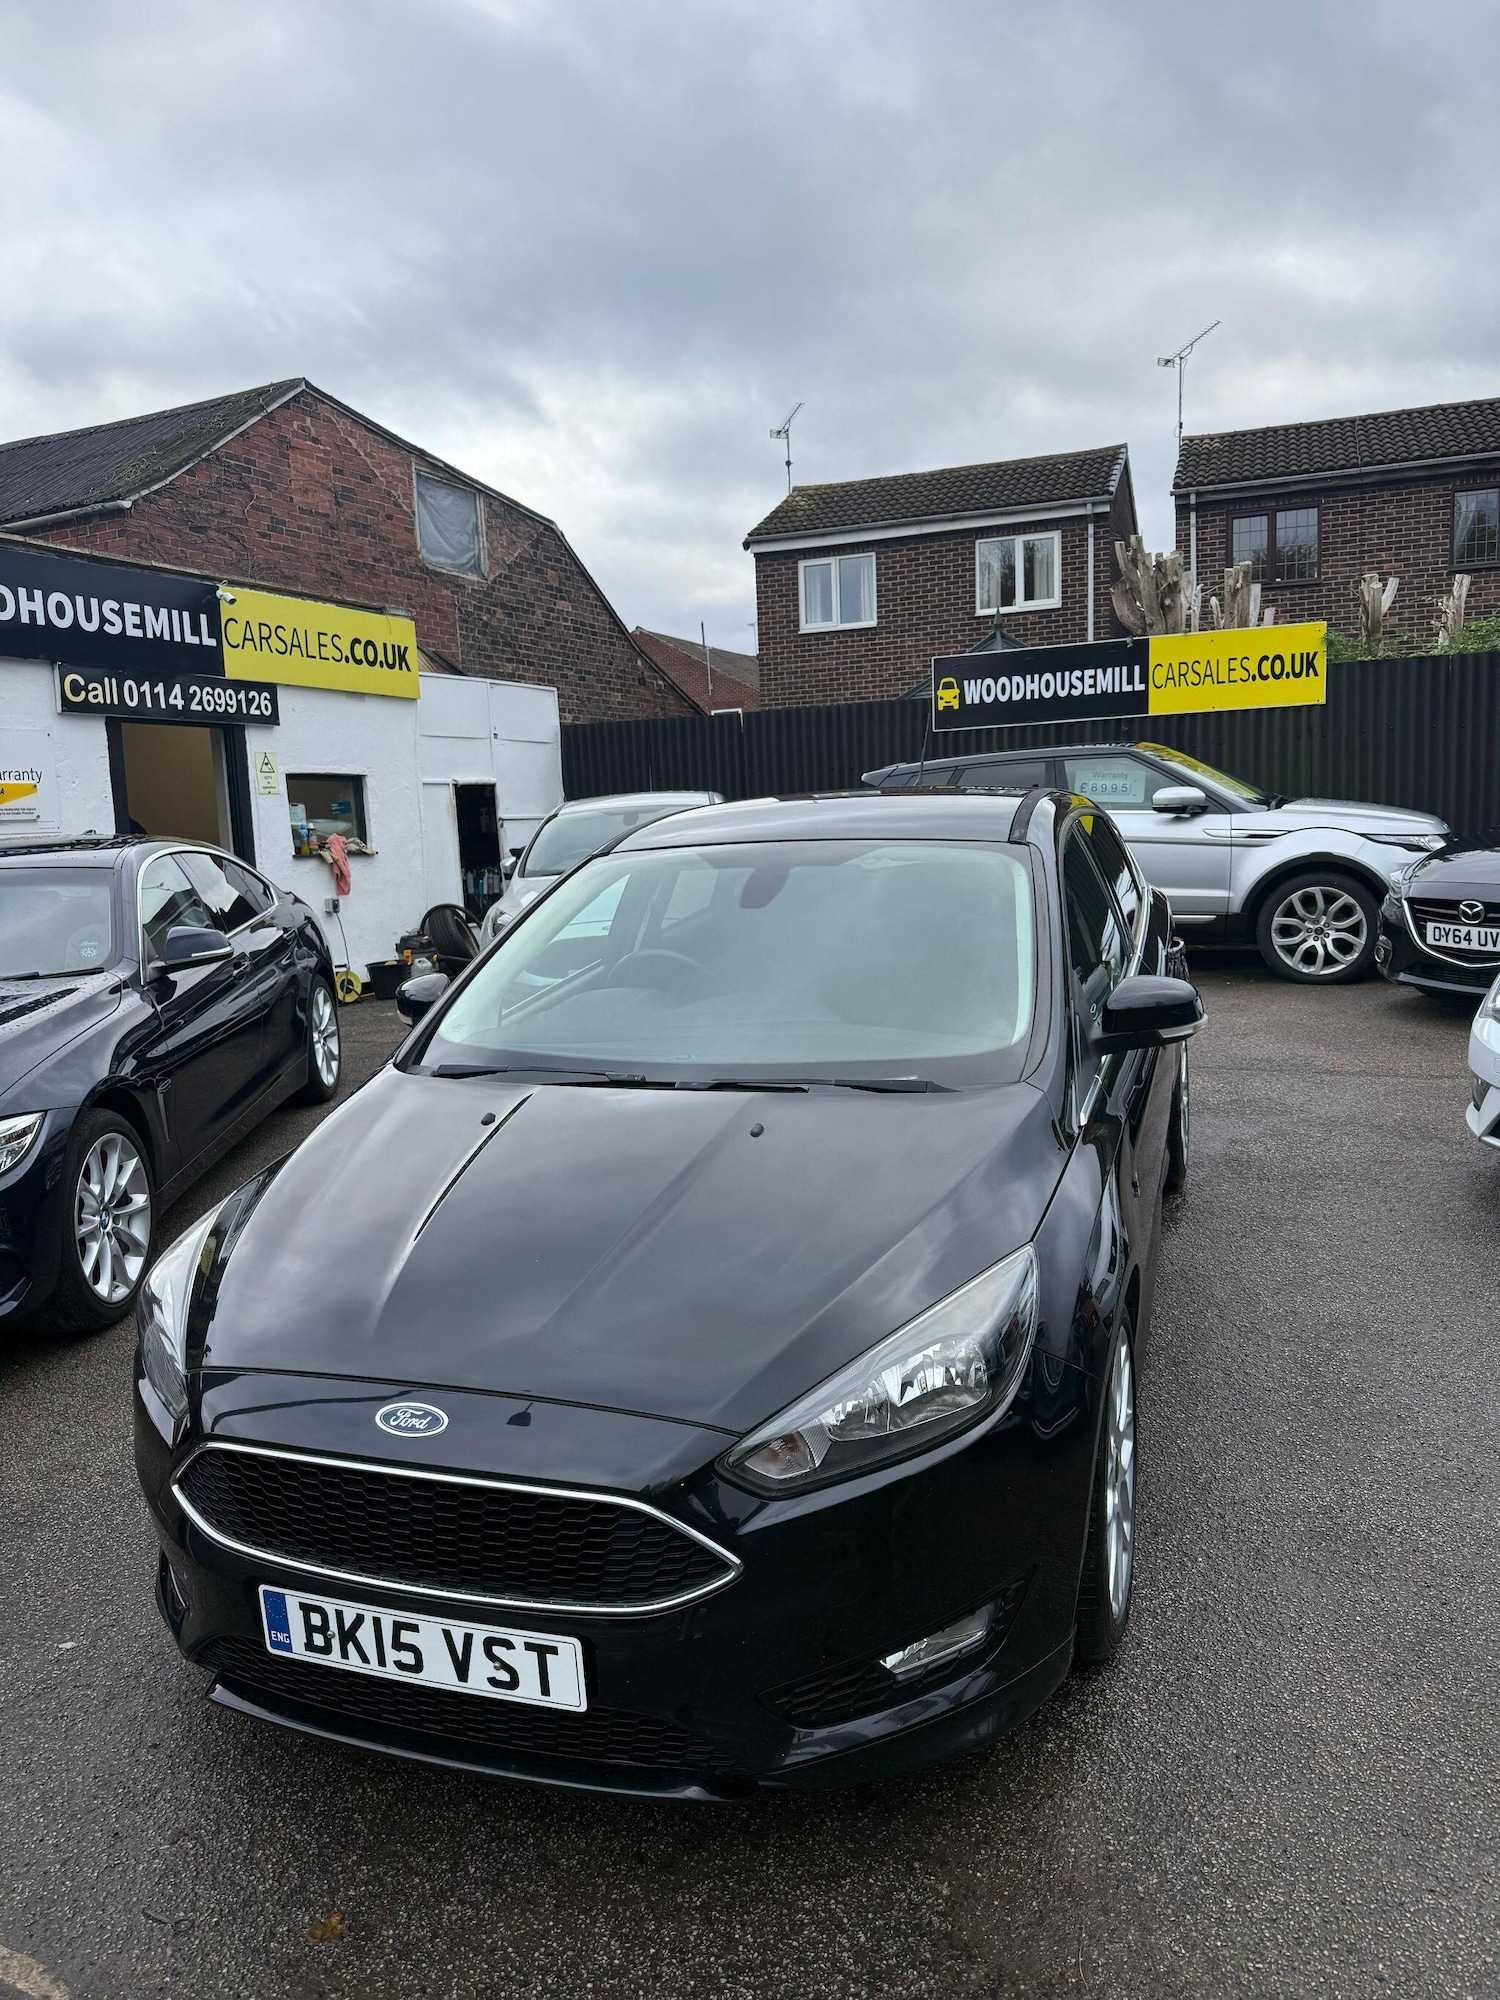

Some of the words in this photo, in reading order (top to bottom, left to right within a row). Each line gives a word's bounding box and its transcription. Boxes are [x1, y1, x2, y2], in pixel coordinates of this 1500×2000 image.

[223, 617, 412, 672] CARSALES.CO.UK
[963, 664, 1146, 705] WOODHOUSEMILL
[1151, 651, 1320, 690] CARSALES.CO.UK
[63, 673, 119, 706] Call
[123, 679, 185, 711] 0114
[188, 685, 272, 716] 2699126
[0, 767, 43, 784] rranty
[1092, 771, 1129, 780] Warranty
[1433, 926, 1473, 946] OY64
[389, 1408, 432, 1430] Ford
[270, 1630, 290, 1644] ENG
[298, 1601, 424, 1675] BK15
[440, 1627, 559, 1697] VST
